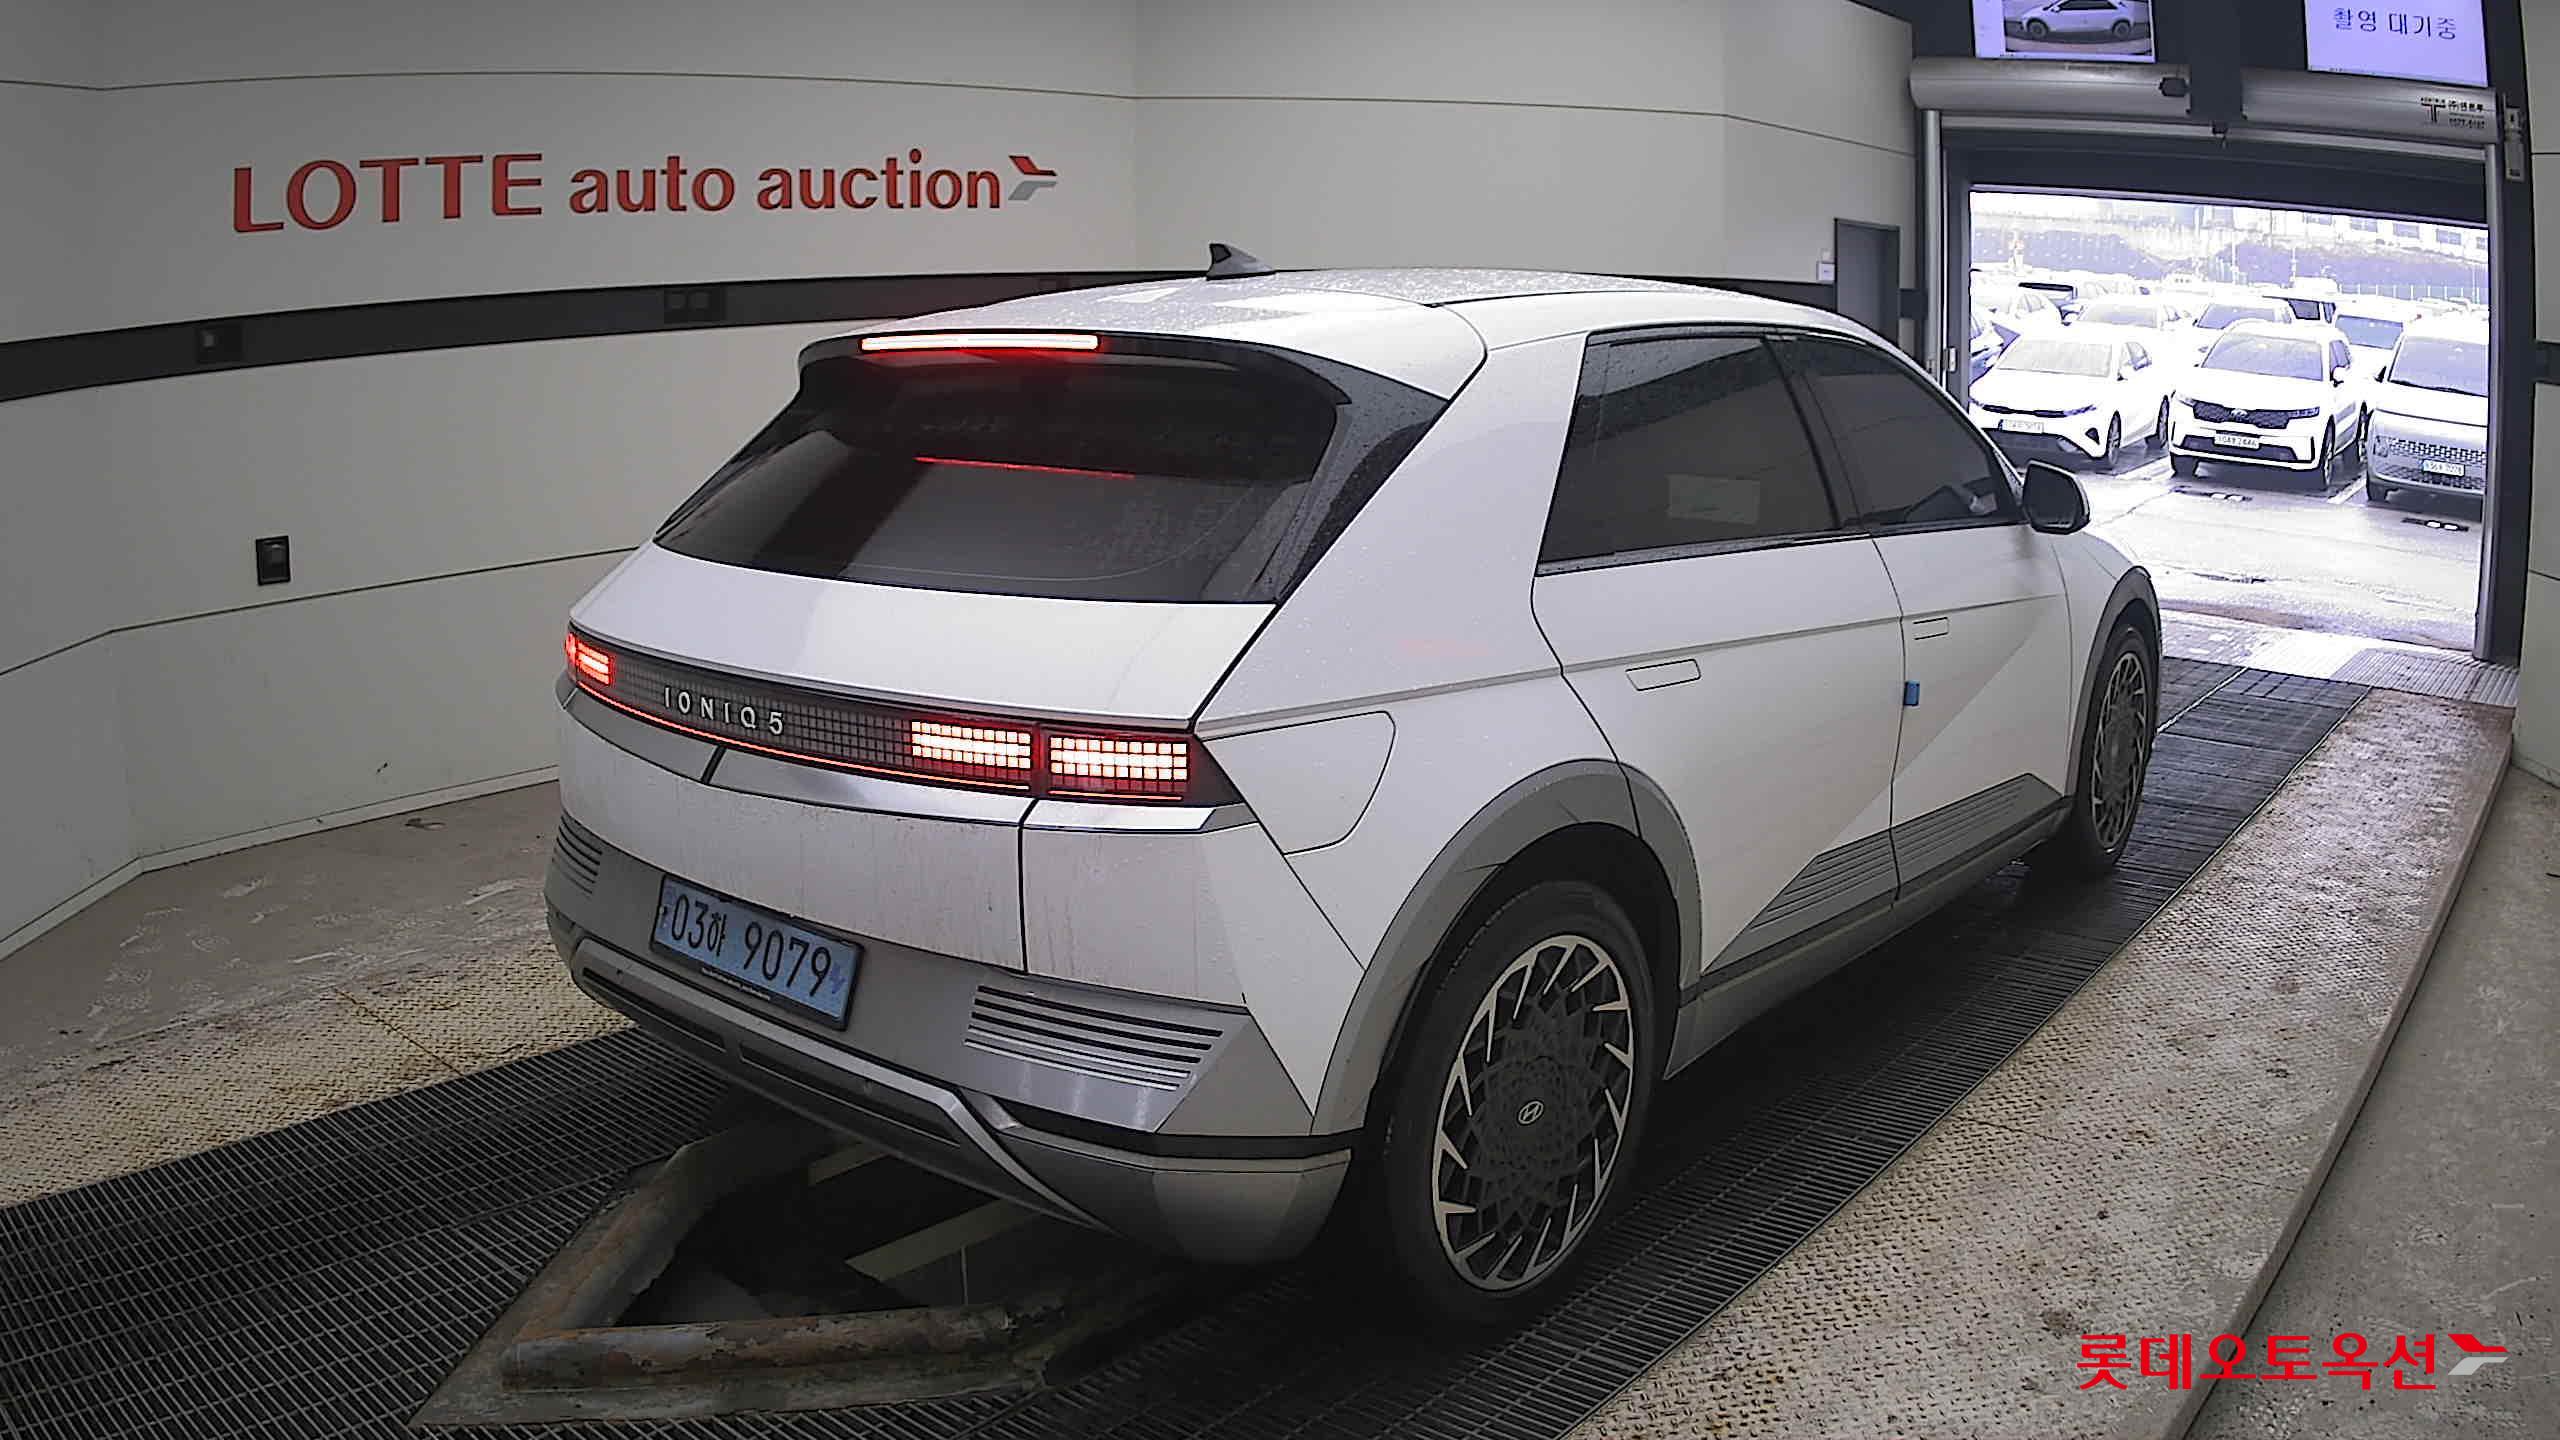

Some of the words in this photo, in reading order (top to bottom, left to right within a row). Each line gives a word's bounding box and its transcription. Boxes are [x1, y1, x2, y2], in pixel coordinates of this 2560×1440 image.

[2334, 8, 2377, 33] 촬영
[2388, 13, 2457, 40] 대기중
[233, 152, 543, 233] LOTTE
[569, 154, 735, 213] auto
[757, 148, 1001, 210] auction
[664, 686, 757, 730] IONIQ
[768, 710, 784, 736] 5
[671, 893, 728, 958] 03하
[743, 920, 832, 998] 9079
